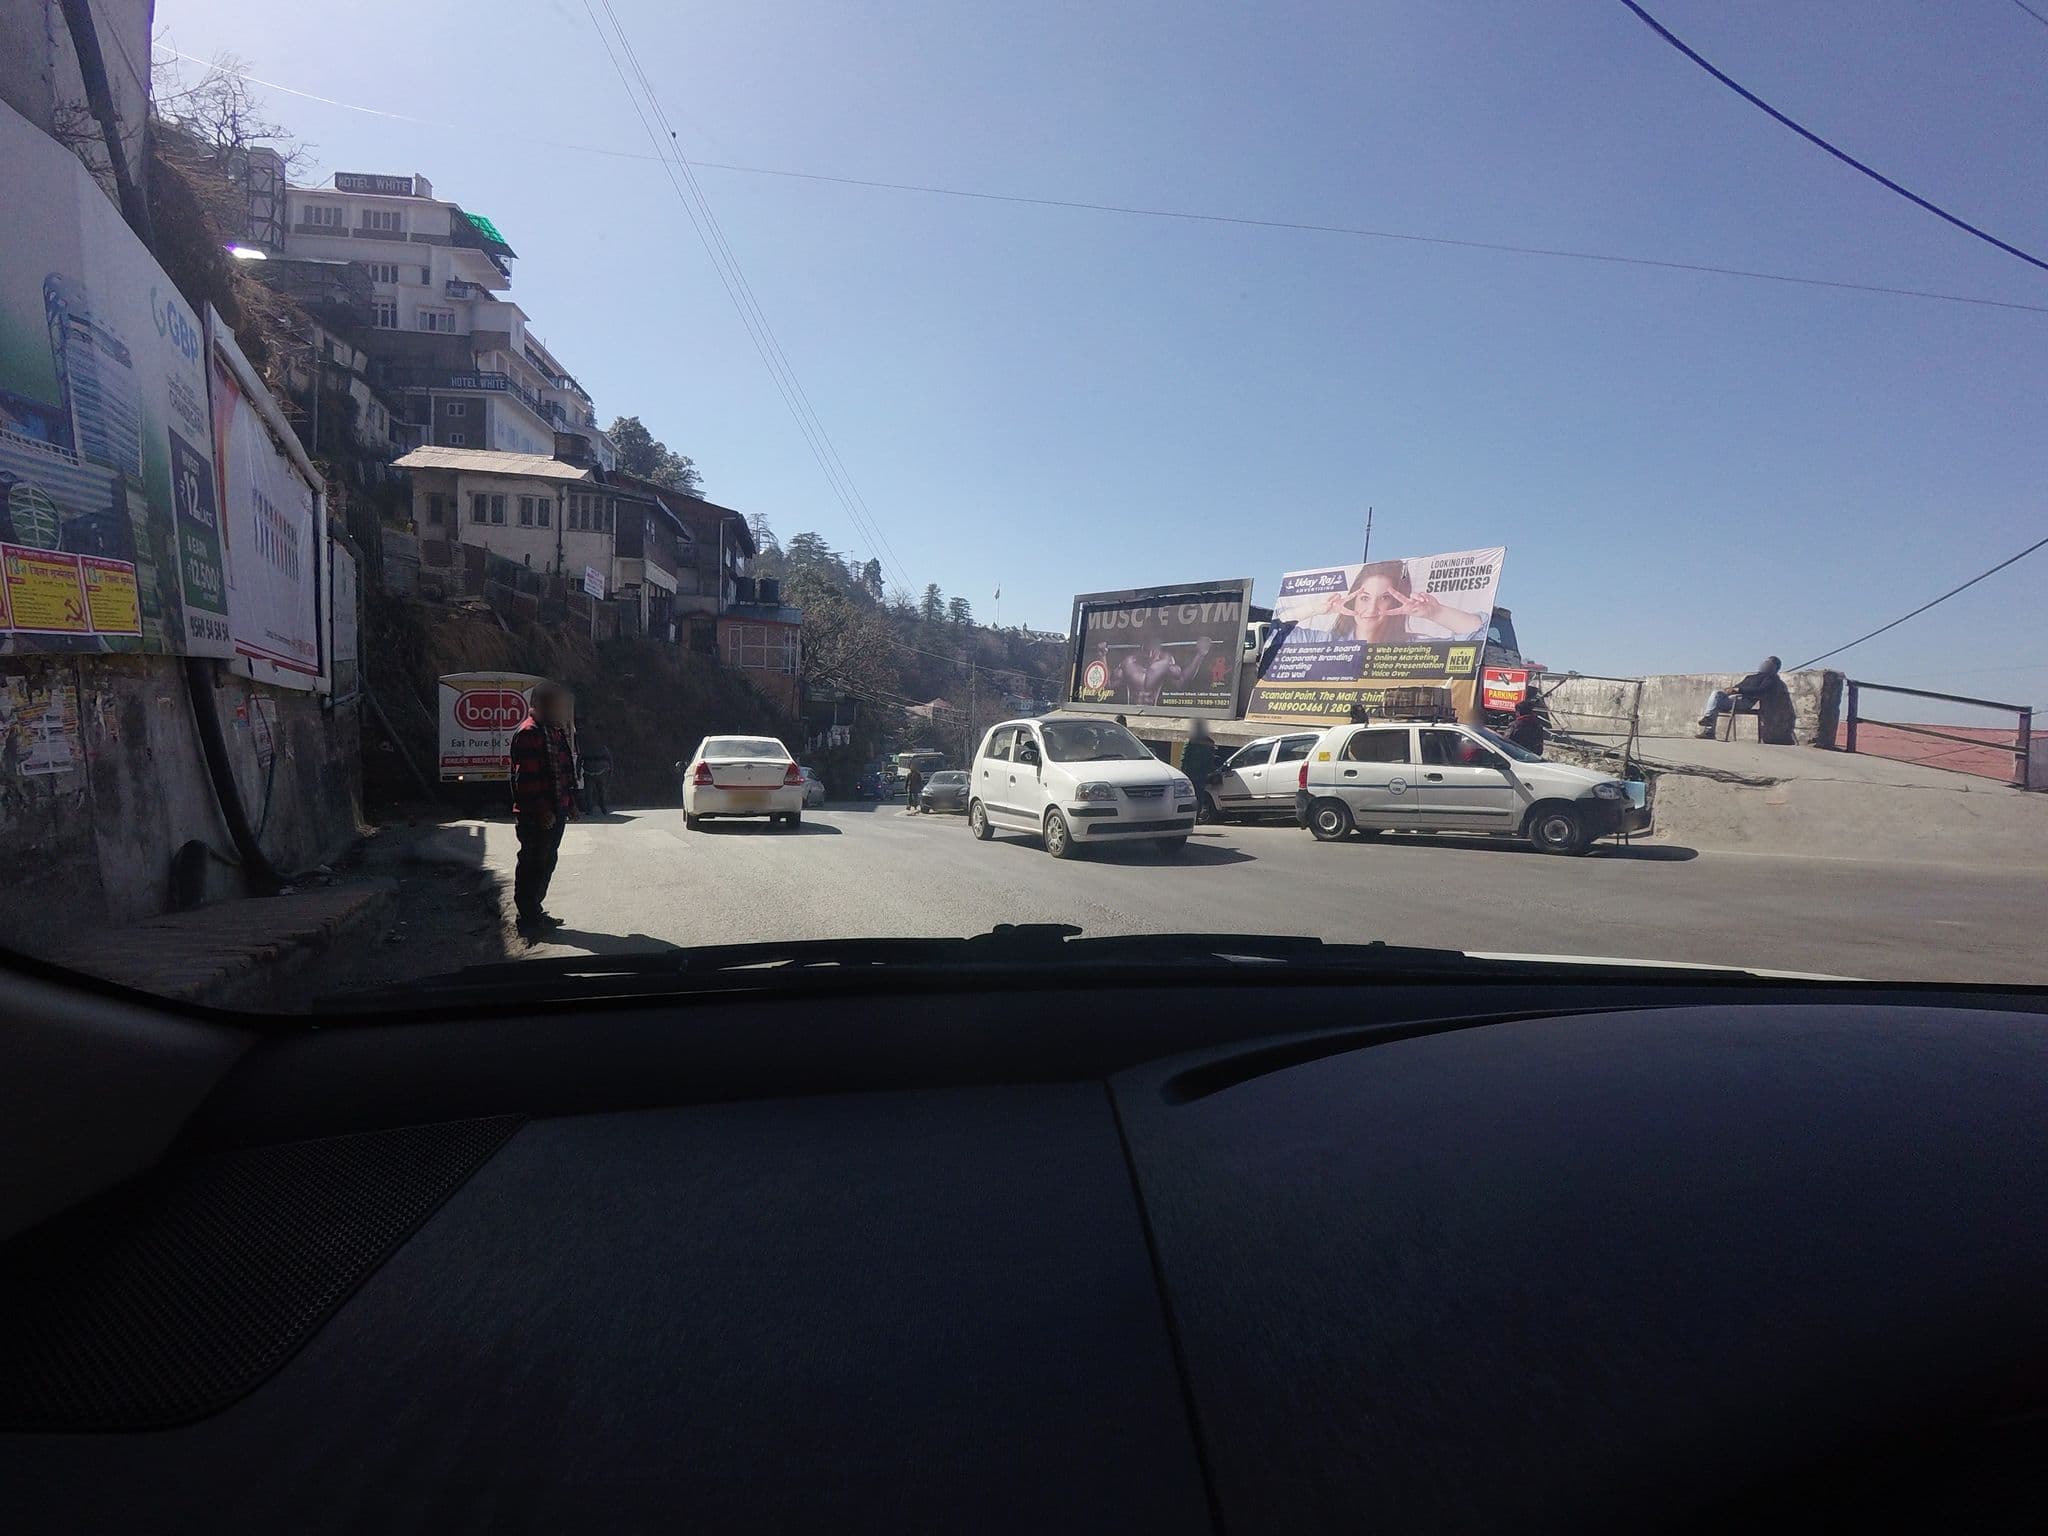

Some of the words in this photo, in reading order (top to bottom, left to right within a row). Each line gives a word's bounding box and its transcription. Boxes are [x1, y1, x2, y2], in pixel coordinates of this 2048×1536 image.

[337, 175, 369, 189] HOTEL
[376, 178, 410, 192] WHITE
[451, 376, 477, 387] HOTEL
[480, 376, 505, 388] WHITE
[1429, 564, 1493, 580] ADVERTISING
[1295, 576, 1318, 590] Uday
[1318, 574, 1336, 587] Raj
[1426, 576, 1491, 593] SERVICES?
[1177, 601, 1239, 625] GYM
[1298, 646, 1325, 654] Banner
[1333, 644, 1361, 653] Boards
[1393, 646, 1432, 655] Designing
[1281, 654, 1318, 663] Corporate
[1318, 653, 1354, 663] Branding
[1400, 653, 1440, 662] Marketing
[1449, 655, 1471, 665] NEW
[1279, 663, 1312, 671] Hoarding
[1291, 670, 1307, 678] Wall
[1260, 691, 1293, 700] Scandal
[1294, 690, 1317, 701] Point,
[1319, 691, 1336, 700] The
[1336, 692, 1358, 702] Mall,
[1488, 690, 1519, 701] PARKING
[466, 698, 520, 720] bonn
[1267, 702, 1323, 713] 9418900466
[451, 738, 465, 748] Eat
[469, 738, 489, 748] Pure
